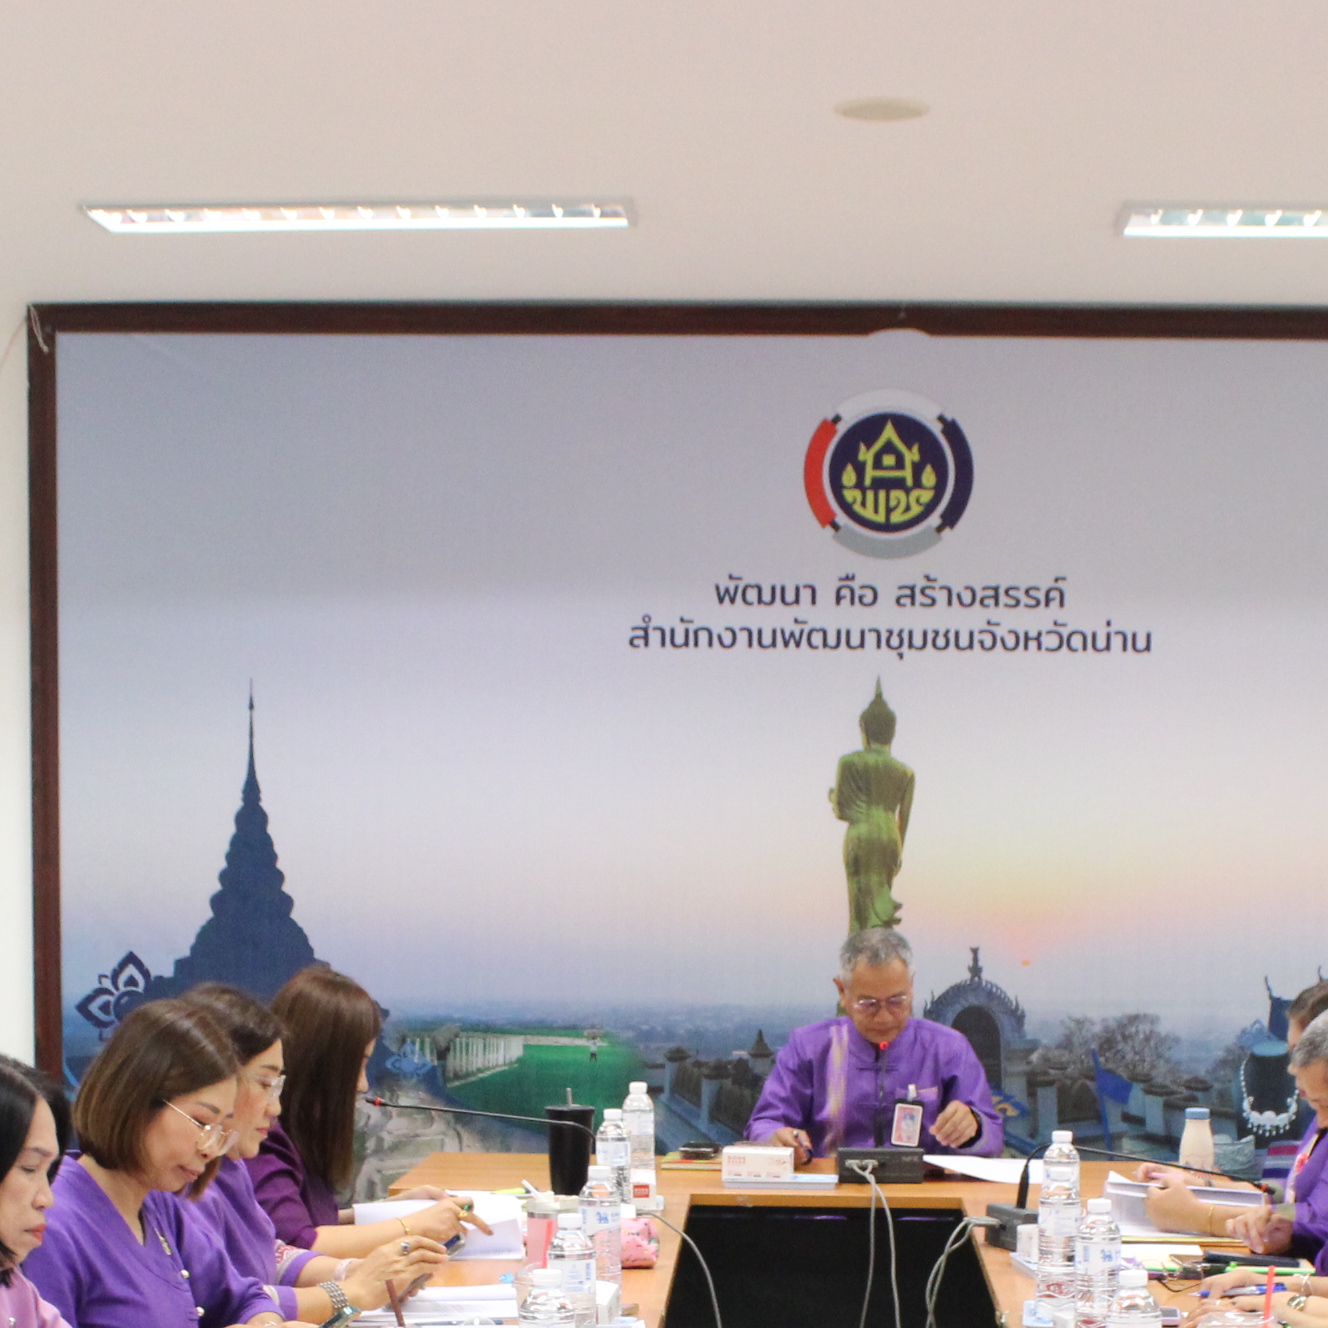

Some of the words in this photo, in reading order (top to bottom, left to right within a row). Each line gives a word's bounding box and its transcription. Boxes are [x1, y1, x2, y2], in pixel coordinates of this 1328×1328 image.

[715, 573, 817, 607] พัฒนา
[834, 573, 878, 607] คือ
[894, 575, 1067, 609] สร้างสรรค์
[628, 615, 1152, 659] สำนักงานพัฒนาชุมชนจังหวัดน่าน
